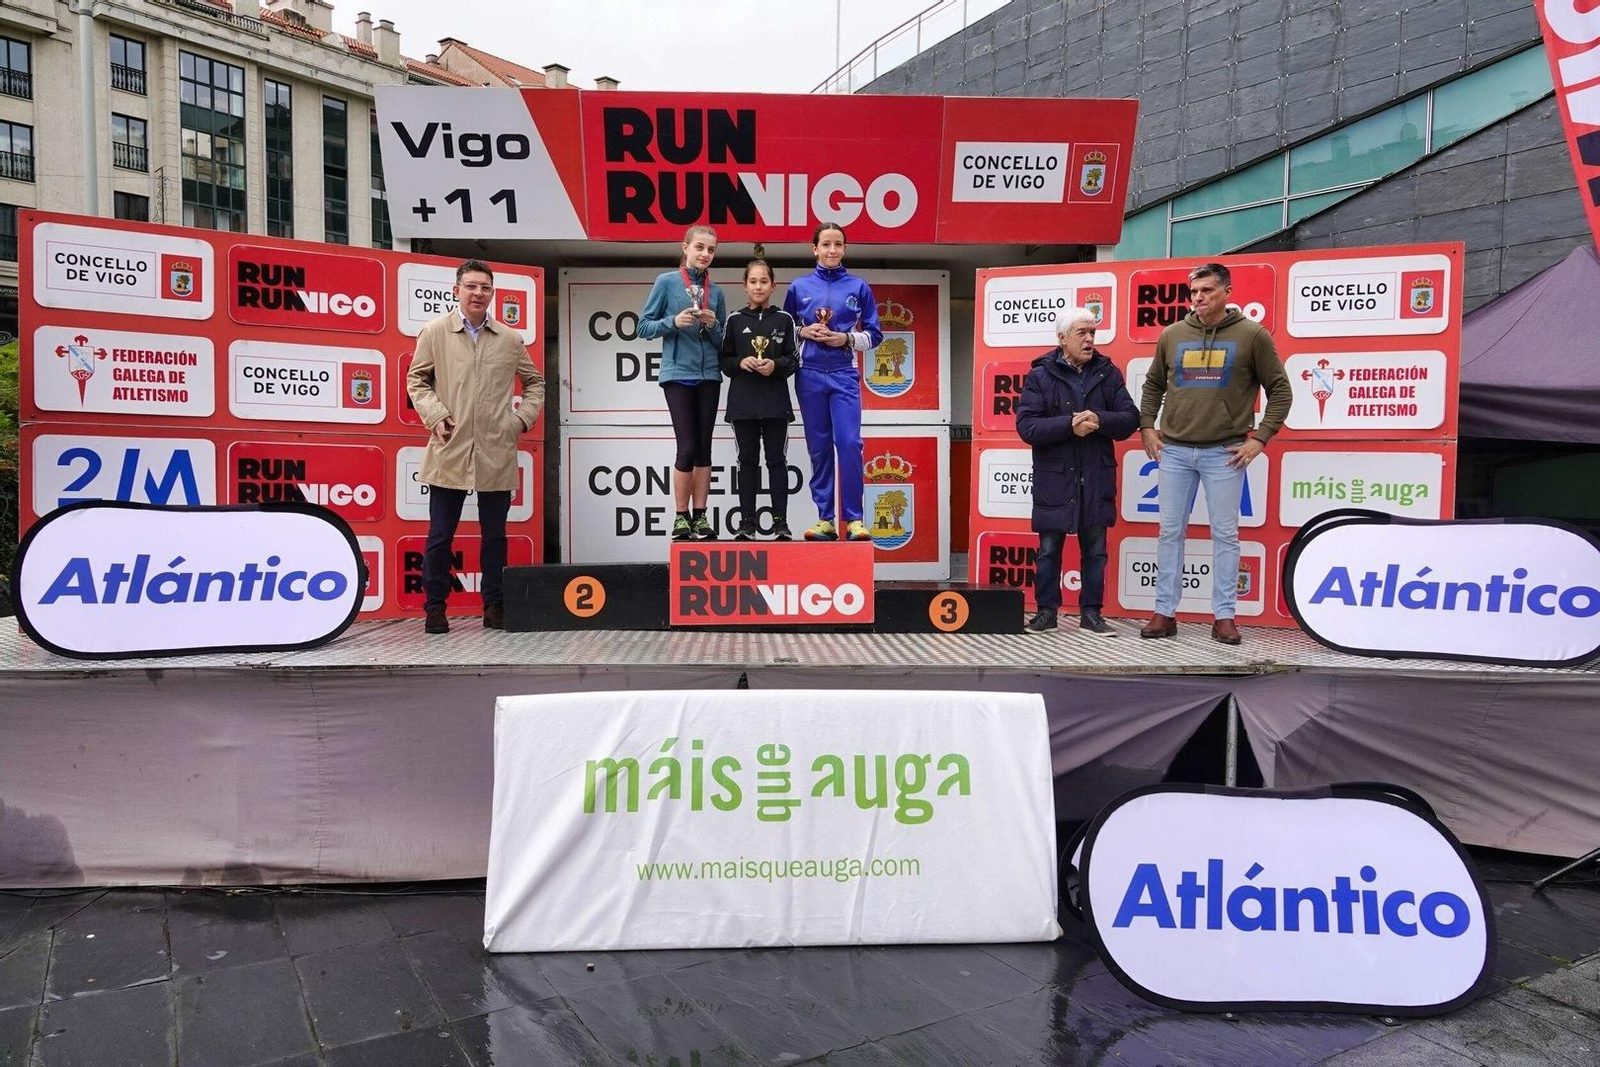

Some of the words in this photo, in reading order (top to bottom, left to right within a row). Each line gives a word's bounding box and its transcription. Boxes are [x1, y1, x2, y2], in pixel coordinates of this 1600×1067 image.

[390, 121, 530, 167] Vigo
[603, 107, 756, 165] RUN
[963, 155, 1058, 171] CONCELLO
[973, 175, 996, 189] DE
[1002, 174, 1045, 189] VIGO
[55, 252, 147, 273] CONCELLO
[66, 268, 89, 283] DE
[95, 270, 138, 286] VIGO
[238, 261, 305, 288] RUN
[415, 288, 460, 302] CONCE
[1301, 282, 1388, 298] CONCELLO
[424, 302, 441, 313] DE
[994, 297, 1065, 311] CONCELLO
[1311, 301, 1329, 312] DE
[1338, 298, 1376, 310] VIGO
[1002, 313, 1019, 324] DE
[1025, 312, 1056, 323] VIGO
[113, 348, 197, 366] FEDERACIÓN
[113, 367, 166, 384] GALEGA
[169, 371, 185, 384] DE
[243, 366, 330, 382] CONCELLO
[616, 353, 662, 382] DE
[1349, 365, 1428, 381] FEDERACIÓN
[113, 386, 189, 403] ATLETISMO
[254, 382, 275, 394] DE
[282, 383, 320, 396] VIGO
[1349, 386, 1396, 399] GALEGA
[1400, 386, 1415, 398] DE
[1347, 403, 1417, 417] ATLETISMO
[238, 458, 306, 481] RUN
[1001, 484, 1017, 494] DE
[1293, 476, 1346, 499] máis
[1351, 479, 1366, 503] que
[1370, 480, 1428, 506] auga
[616, 507, 666, 537] DE
[680, 551, 767, 581] RUN
[37, 554, 348, 605] Atlántico
[576, 584, 594, 610] 2
[1308, 564, 1600, 618] Atlántico
[940, 598, 957, 624] 3
[583, 737, 742, 815] máis
[756, 743, 801, 822] que
[811, 752, 971, 825] auga
[636, 855, 921, 883] www.maisqueauga.com
[1112, 858, 1471, 938] Atlántico
